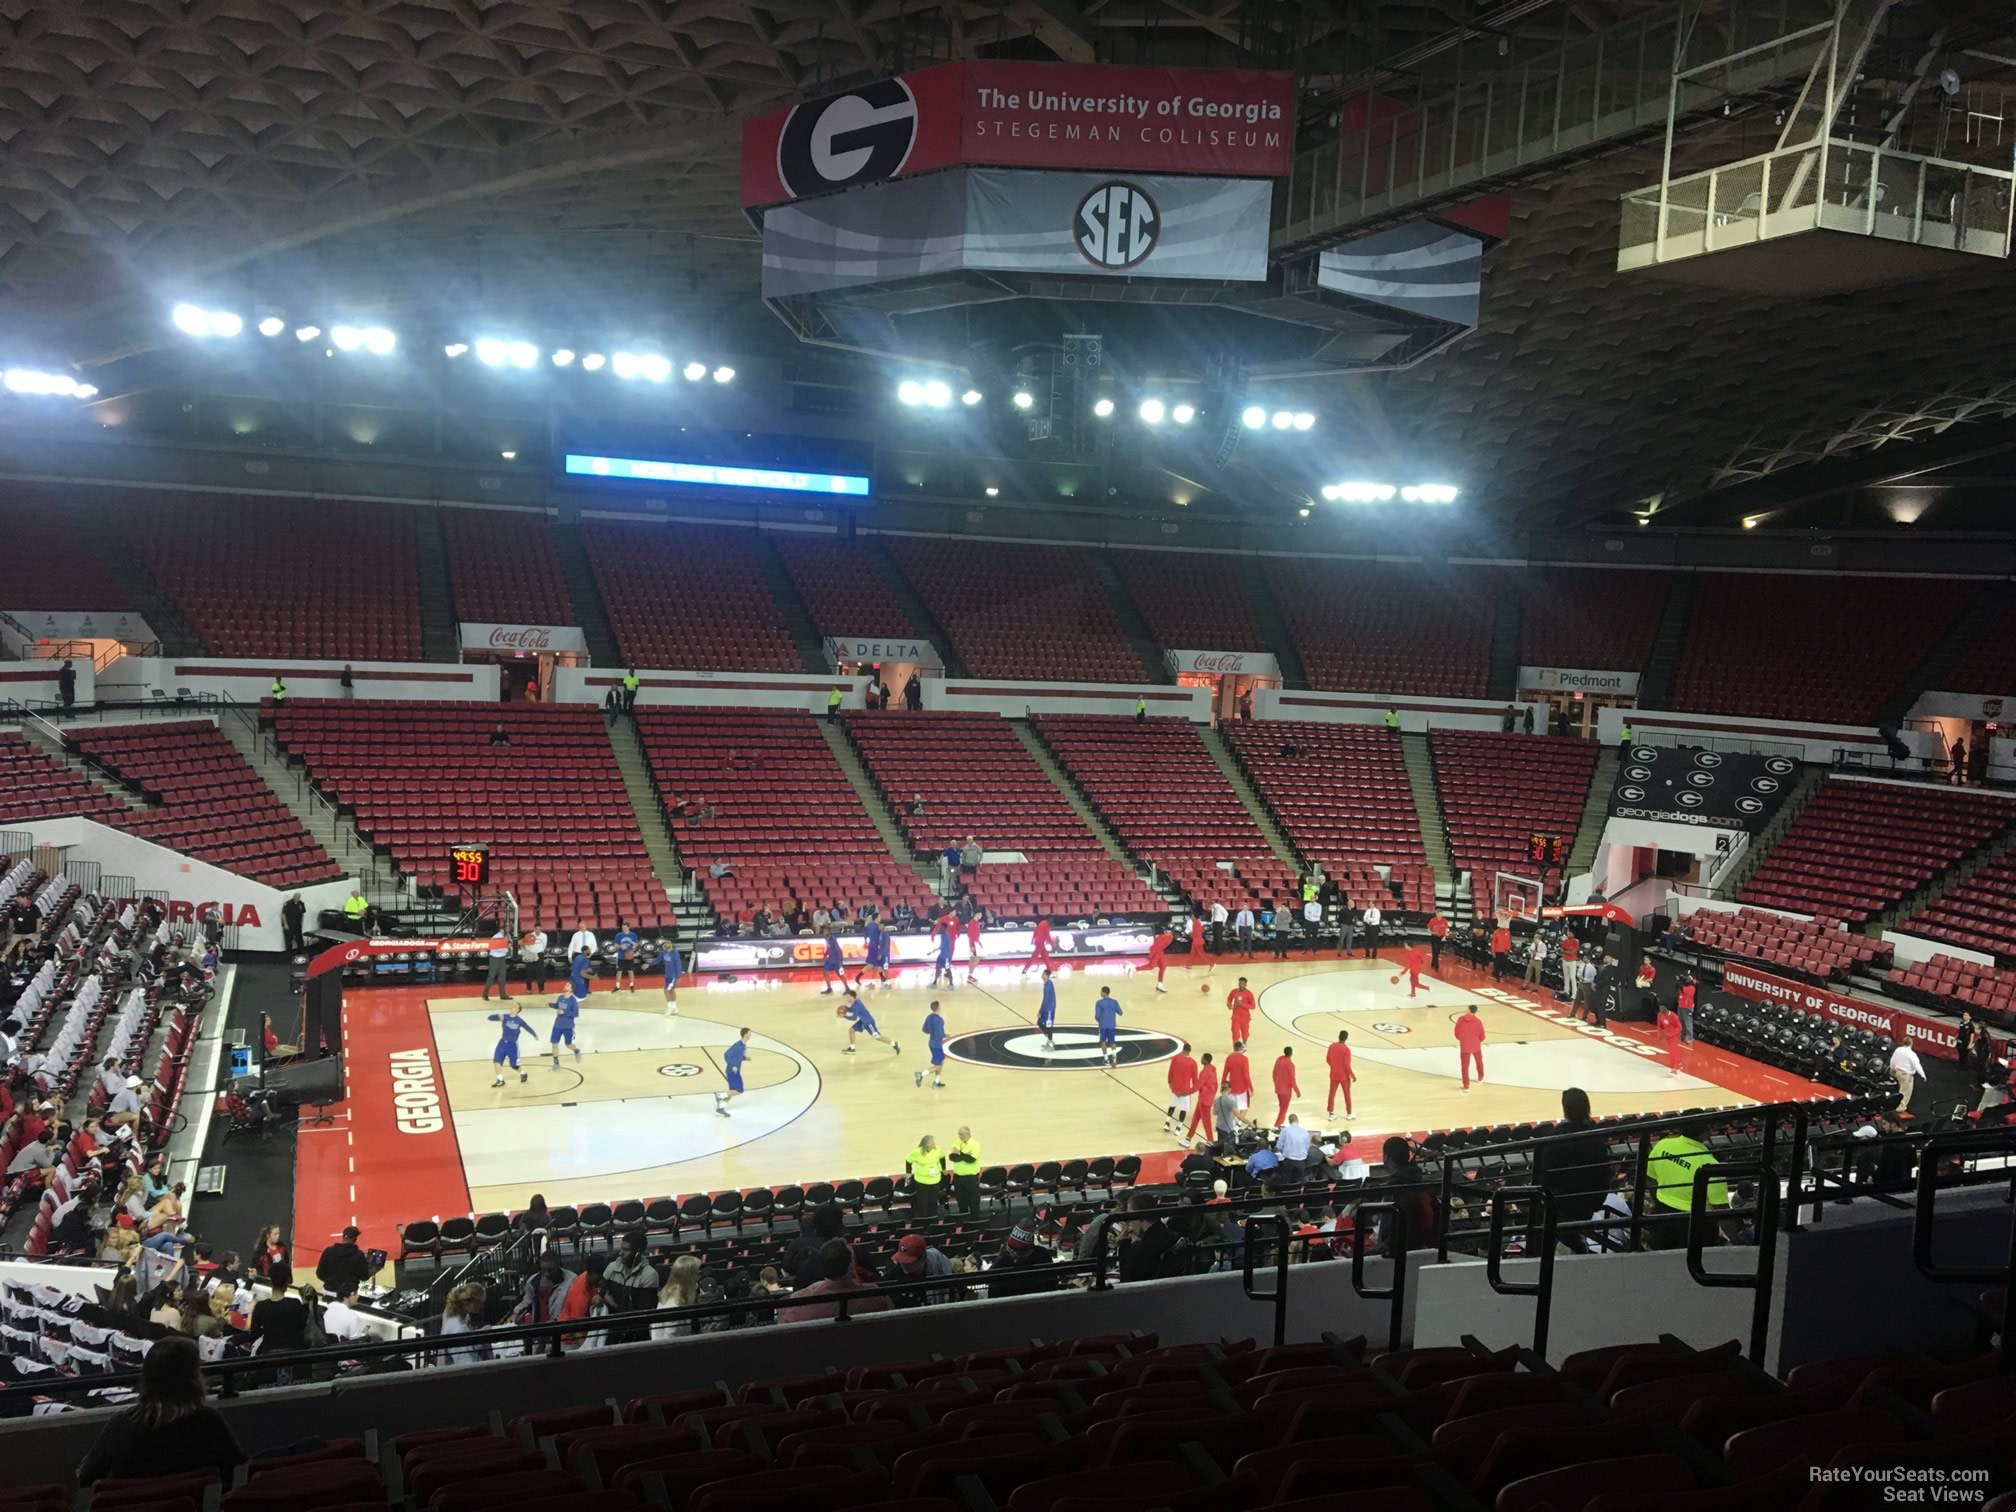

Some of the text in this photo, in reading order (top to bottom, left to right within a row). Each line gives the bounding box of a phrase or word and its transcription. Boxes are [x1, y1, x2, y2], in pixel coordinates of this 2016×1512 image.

[977, 88, 1281, 124] The University of Georgia
[976, 121, 1279, 147] STEGEMAN COLISEUM
[1080, 186, 1155, 265] SEC
[489, 627, 552, 648] Coca-Cola
[856, 643, 919, 658] DELTA
[1194, 653, 1244, 672] Coca-Cola
[1559, 673, 1621, 688] Piedmont
[1616, 806, 1743, 827] georgiadogs.com
[1718, 840, 1726, 850] 2
[457, 862, 478, 880] 30
[1726, 971, 1801, 1003] UNIVERSITY
[1806, 996, 1823, 1009] OF
[1829, 1002, 1891, 1031] GEORGIA
[1471, 988, 1669, 1055] BULLDOGS
[389, 1047, 444, 1134] GEORGIA
